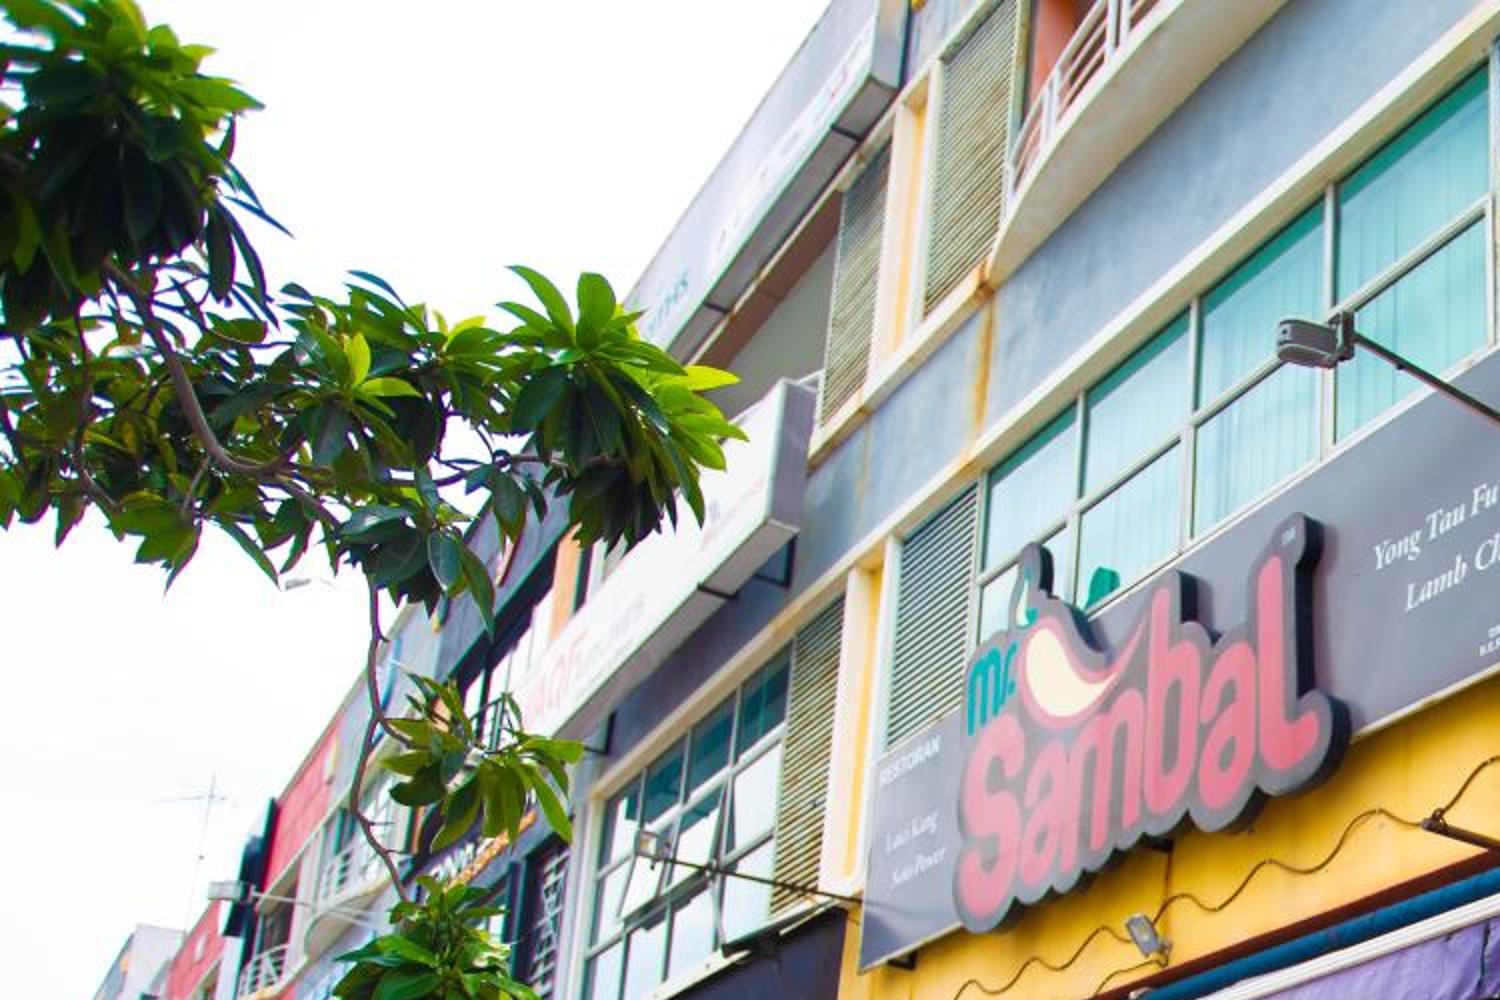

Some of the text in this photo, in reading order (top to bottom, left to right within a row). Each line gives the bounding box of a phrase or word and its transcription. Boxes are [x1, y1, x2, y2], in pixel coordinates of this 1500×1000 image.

[1373, 482, 1499, 571] Yong Tau Fu
[1405, 552, 1468, 612] Lamb
[878, 734, 941, 786] RESTORAN
[959, 555, 1320, 919] Sambal
